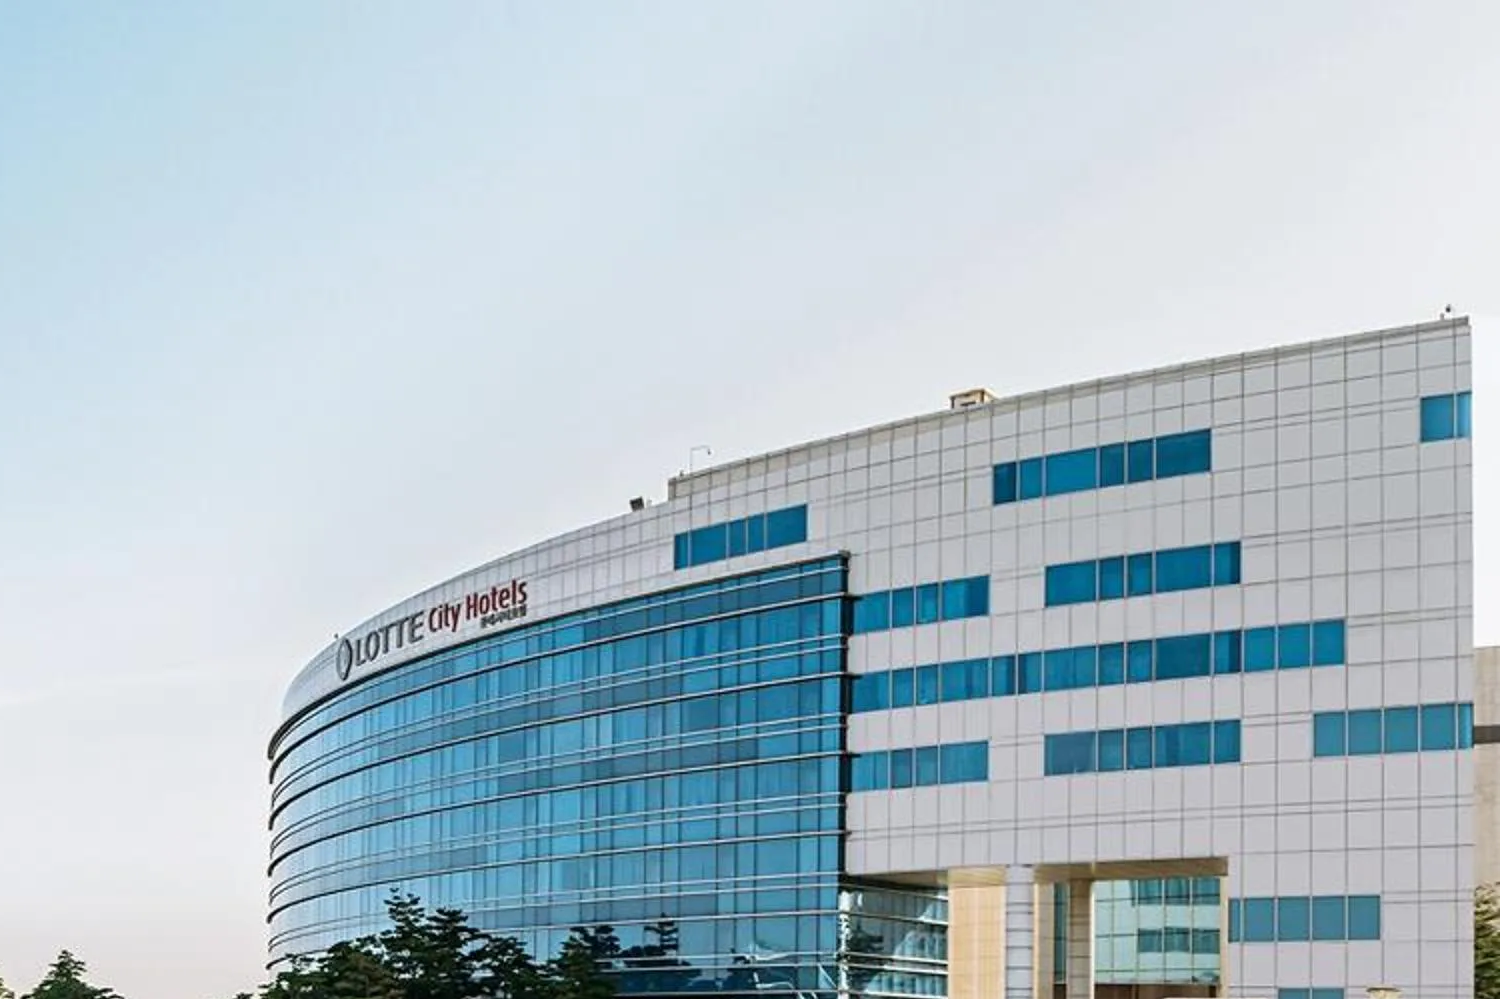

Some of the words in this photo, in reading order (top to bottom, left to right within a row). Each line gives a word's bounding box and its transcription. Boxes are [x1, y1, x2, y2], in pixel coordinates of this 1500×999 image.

[355, 609, 425, 667] LOTTE
[428, 603, 461, 632] City
[466, 579, 527, 620] Hotels
